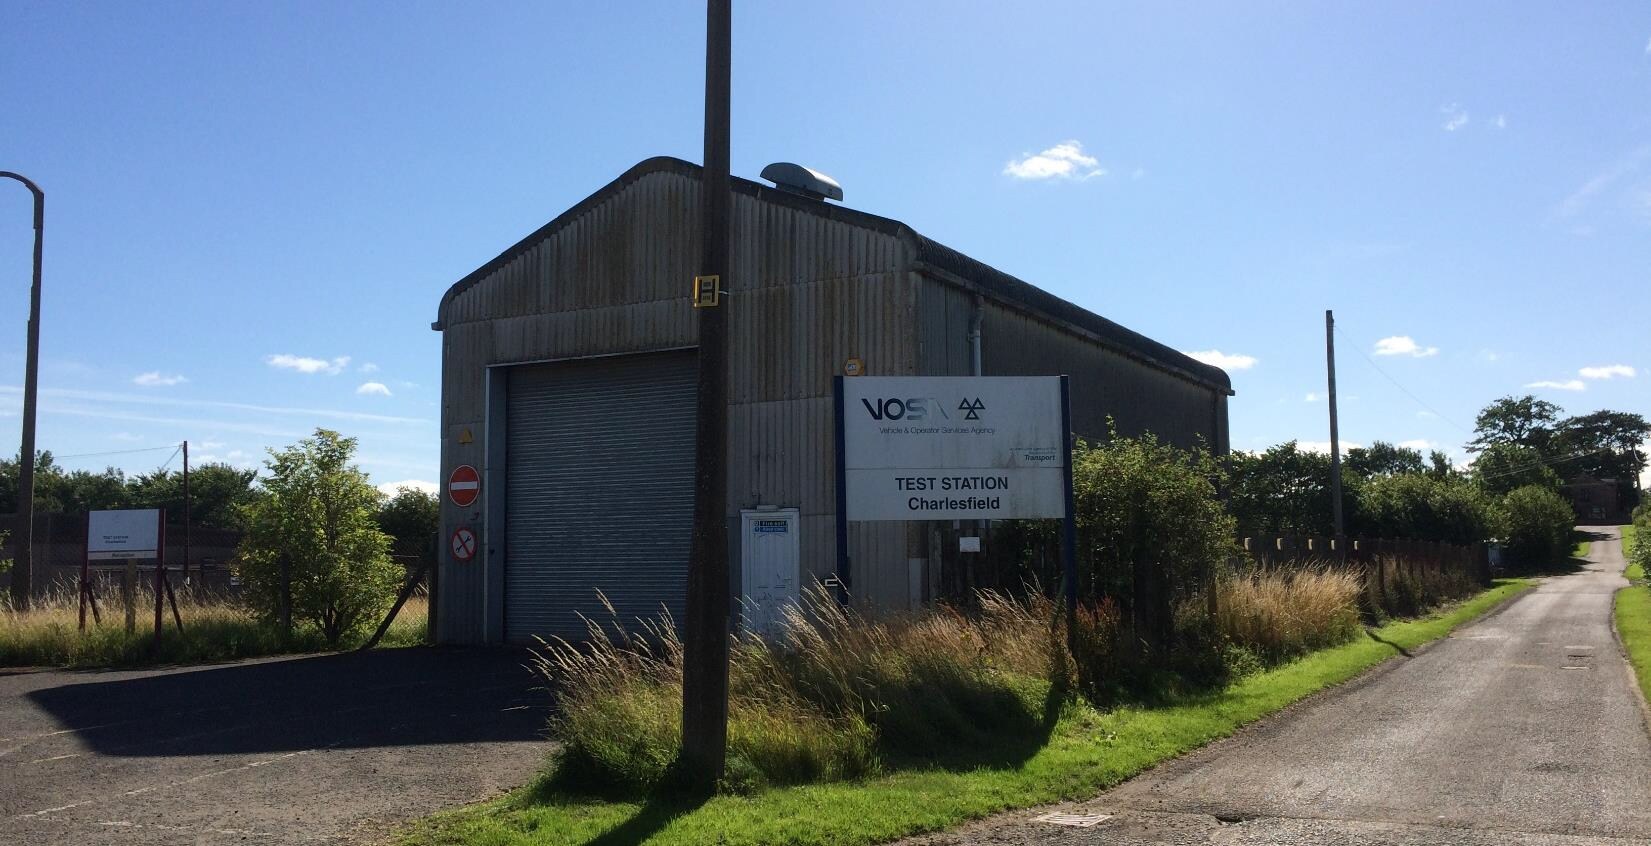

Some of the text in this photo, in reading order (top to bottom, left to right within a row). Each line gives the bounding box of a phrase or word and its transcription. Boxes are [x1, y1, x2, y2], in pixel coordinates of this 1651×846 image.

[880, 426, 903, 434] Vehicle
[911, 426, 939, 435] Operator
[942, 426, 969, 434] Services
[971, 426, 995, 435] Agency
[1024, 454, 1056, 462] Transport
[895, 476, 1008, 490] TEST STATION
[908, 496, 1000, 510] Charlesfield
